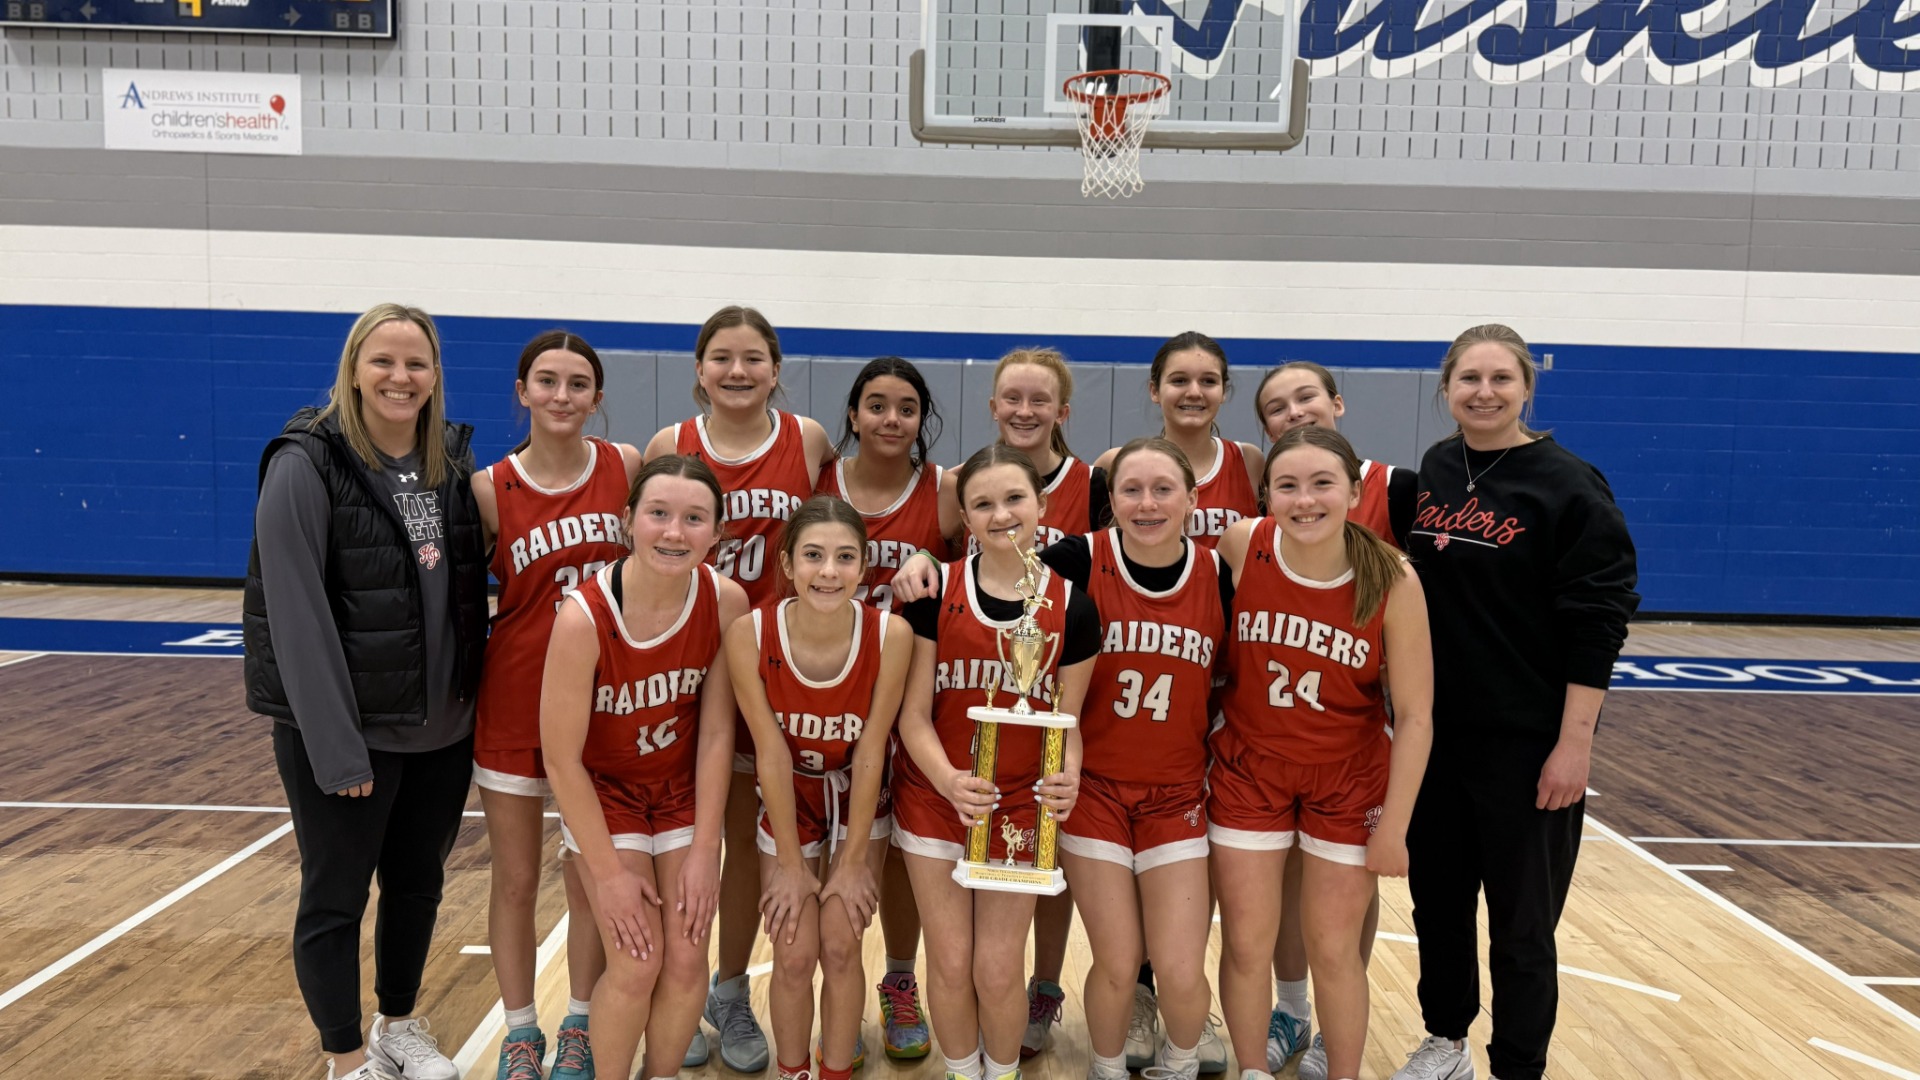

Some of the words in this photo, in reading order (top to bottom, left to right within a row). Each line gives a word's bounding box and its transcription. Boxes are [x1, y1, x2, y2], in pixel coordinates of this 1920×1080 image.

[118, 81, 194, 109] ANDREWS
[196, 92, 261, 104] INSTITUTE
[152, 129, 205, 140] Orthopaedics
[207, 131, 213, 139] &
[215, 131, 241, 141] Sports
[243, 132, 279, 141] Medicine
[1100, 620, 1214, 669] AIDERS
[1238, 610, 1371, 670] RAIDERS
[1113, 669, 1174, 722] 34
[1267, 659, 1327, 712] 24
[799, 749, 824, 771] 3
